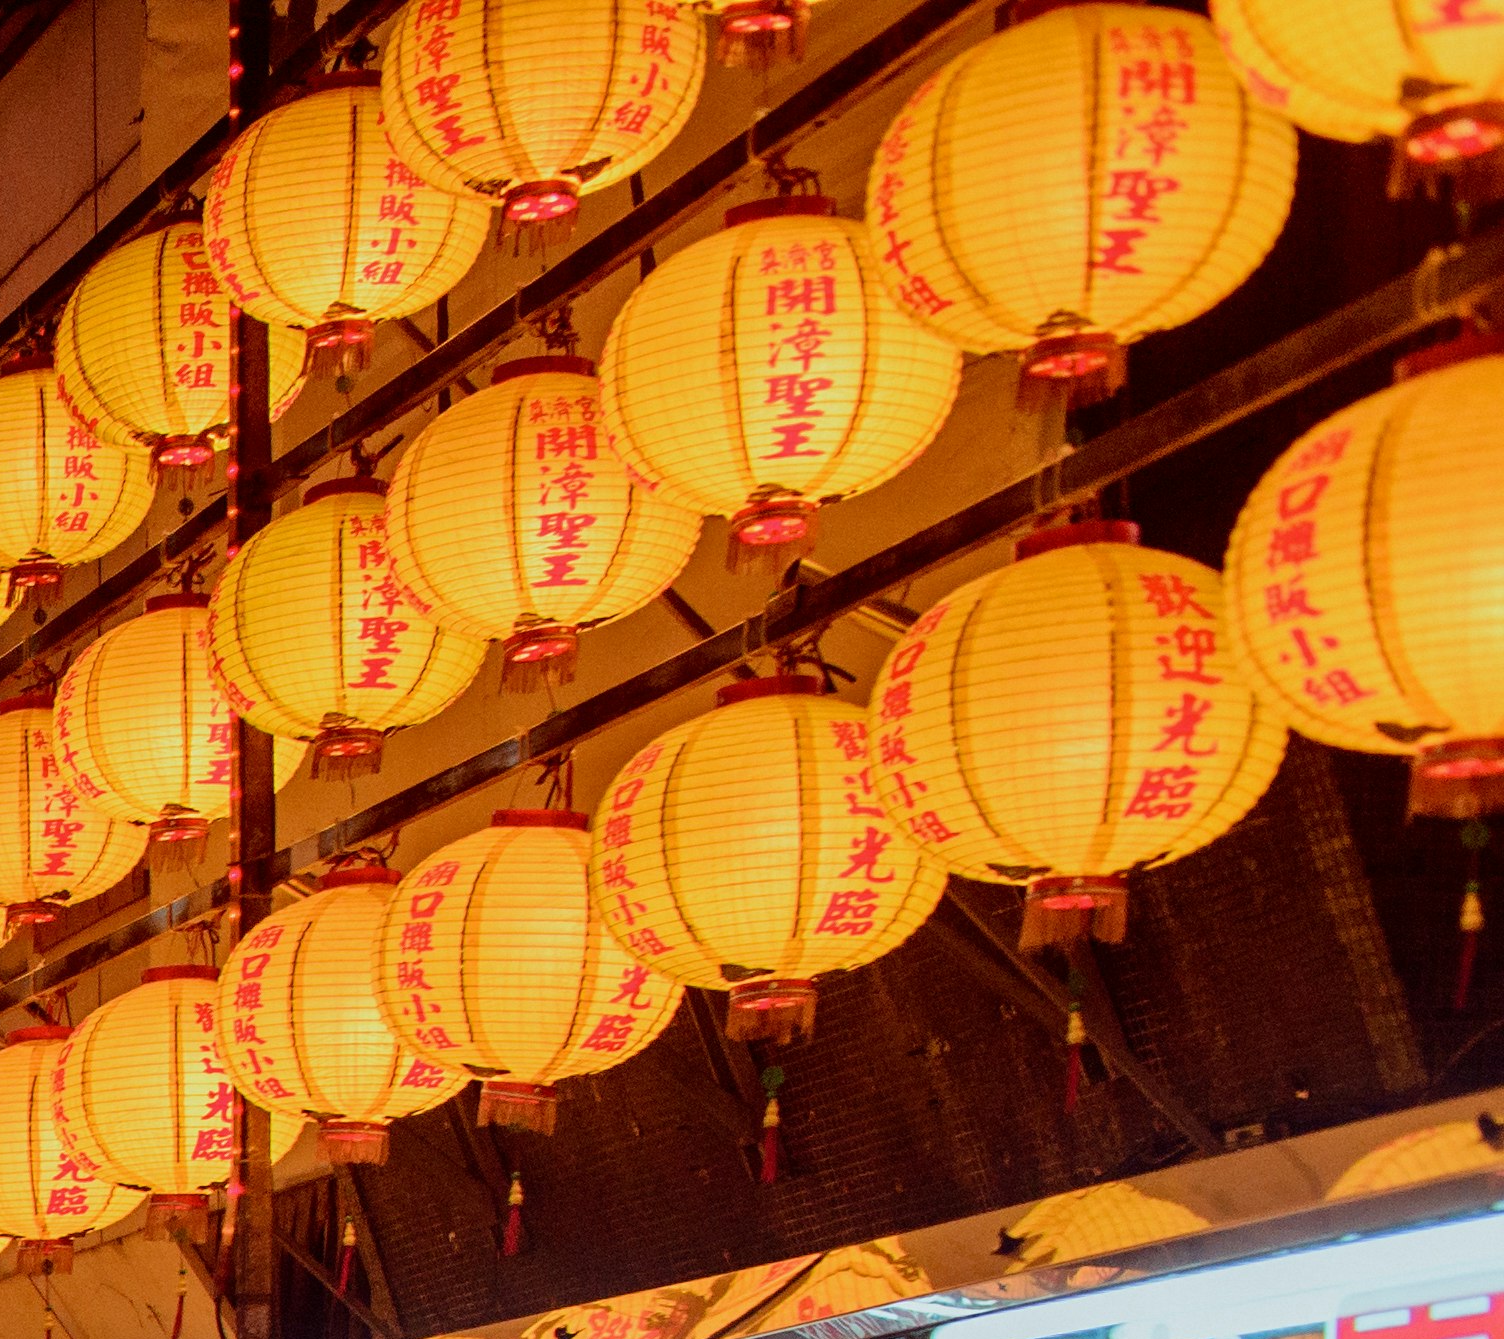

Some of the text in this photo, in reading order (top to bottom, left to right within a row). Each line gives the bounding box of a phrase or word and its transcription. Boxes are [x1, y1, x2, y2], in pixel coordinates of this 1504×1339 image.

[1094, 63, 1196, 275] 開漳聖王
[762, 278, 836, 460] 開漳聖王
[534, 424, 598, 588] 開漳聖王
[1128, 578, 1218, 820] 歡迎光臨
